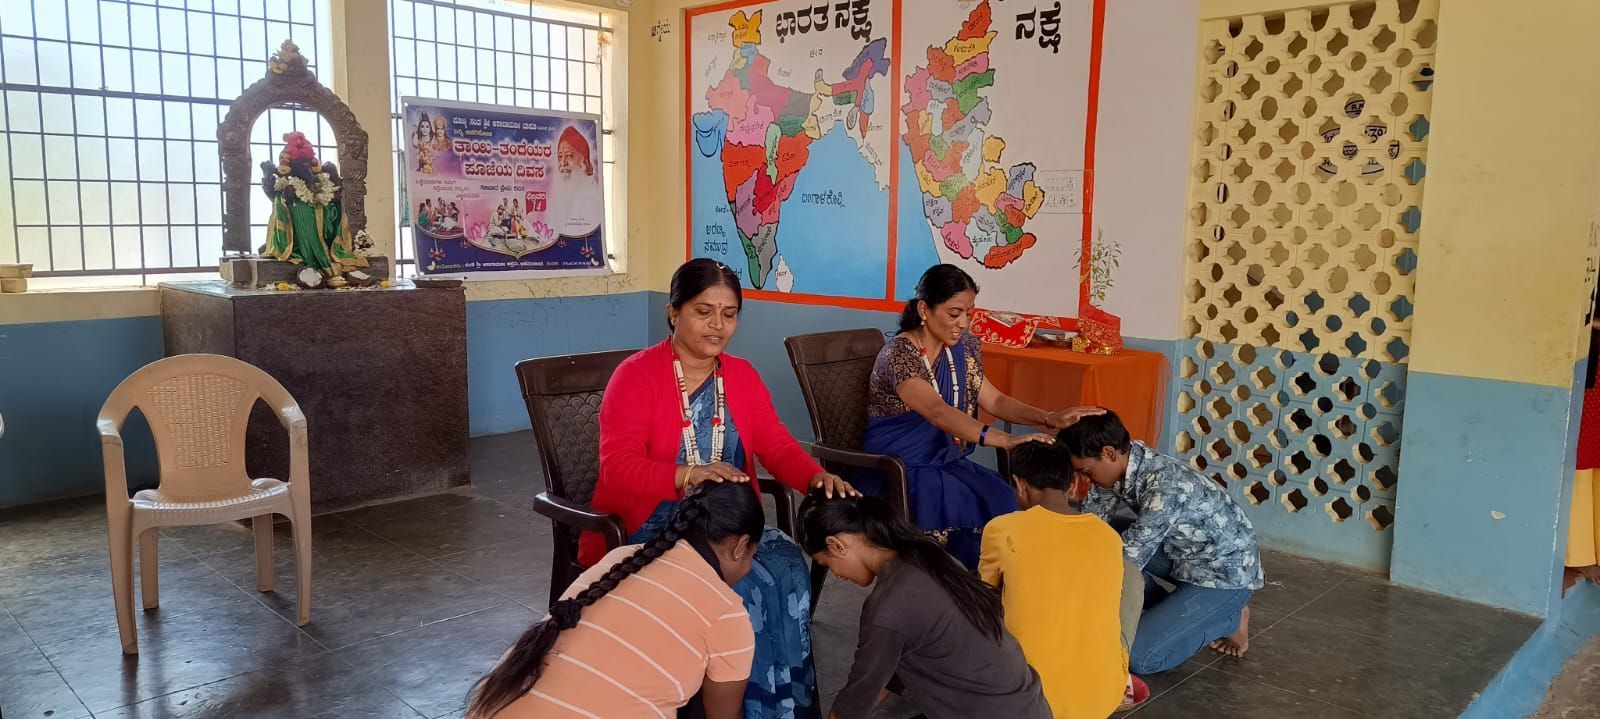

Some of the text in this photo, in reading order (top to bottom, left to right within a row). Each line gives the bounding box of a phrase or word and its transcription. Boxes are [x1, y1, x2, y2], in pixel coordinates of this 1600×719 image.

[776, 0, 872, 44] ಭಾರತ ನಕ್ಷ
[1015, 1, 1061, 54] ನಕ್ಷೆ
[465, 161, 545, 178] ಪೂಜೆಯ ದಿವಸ
